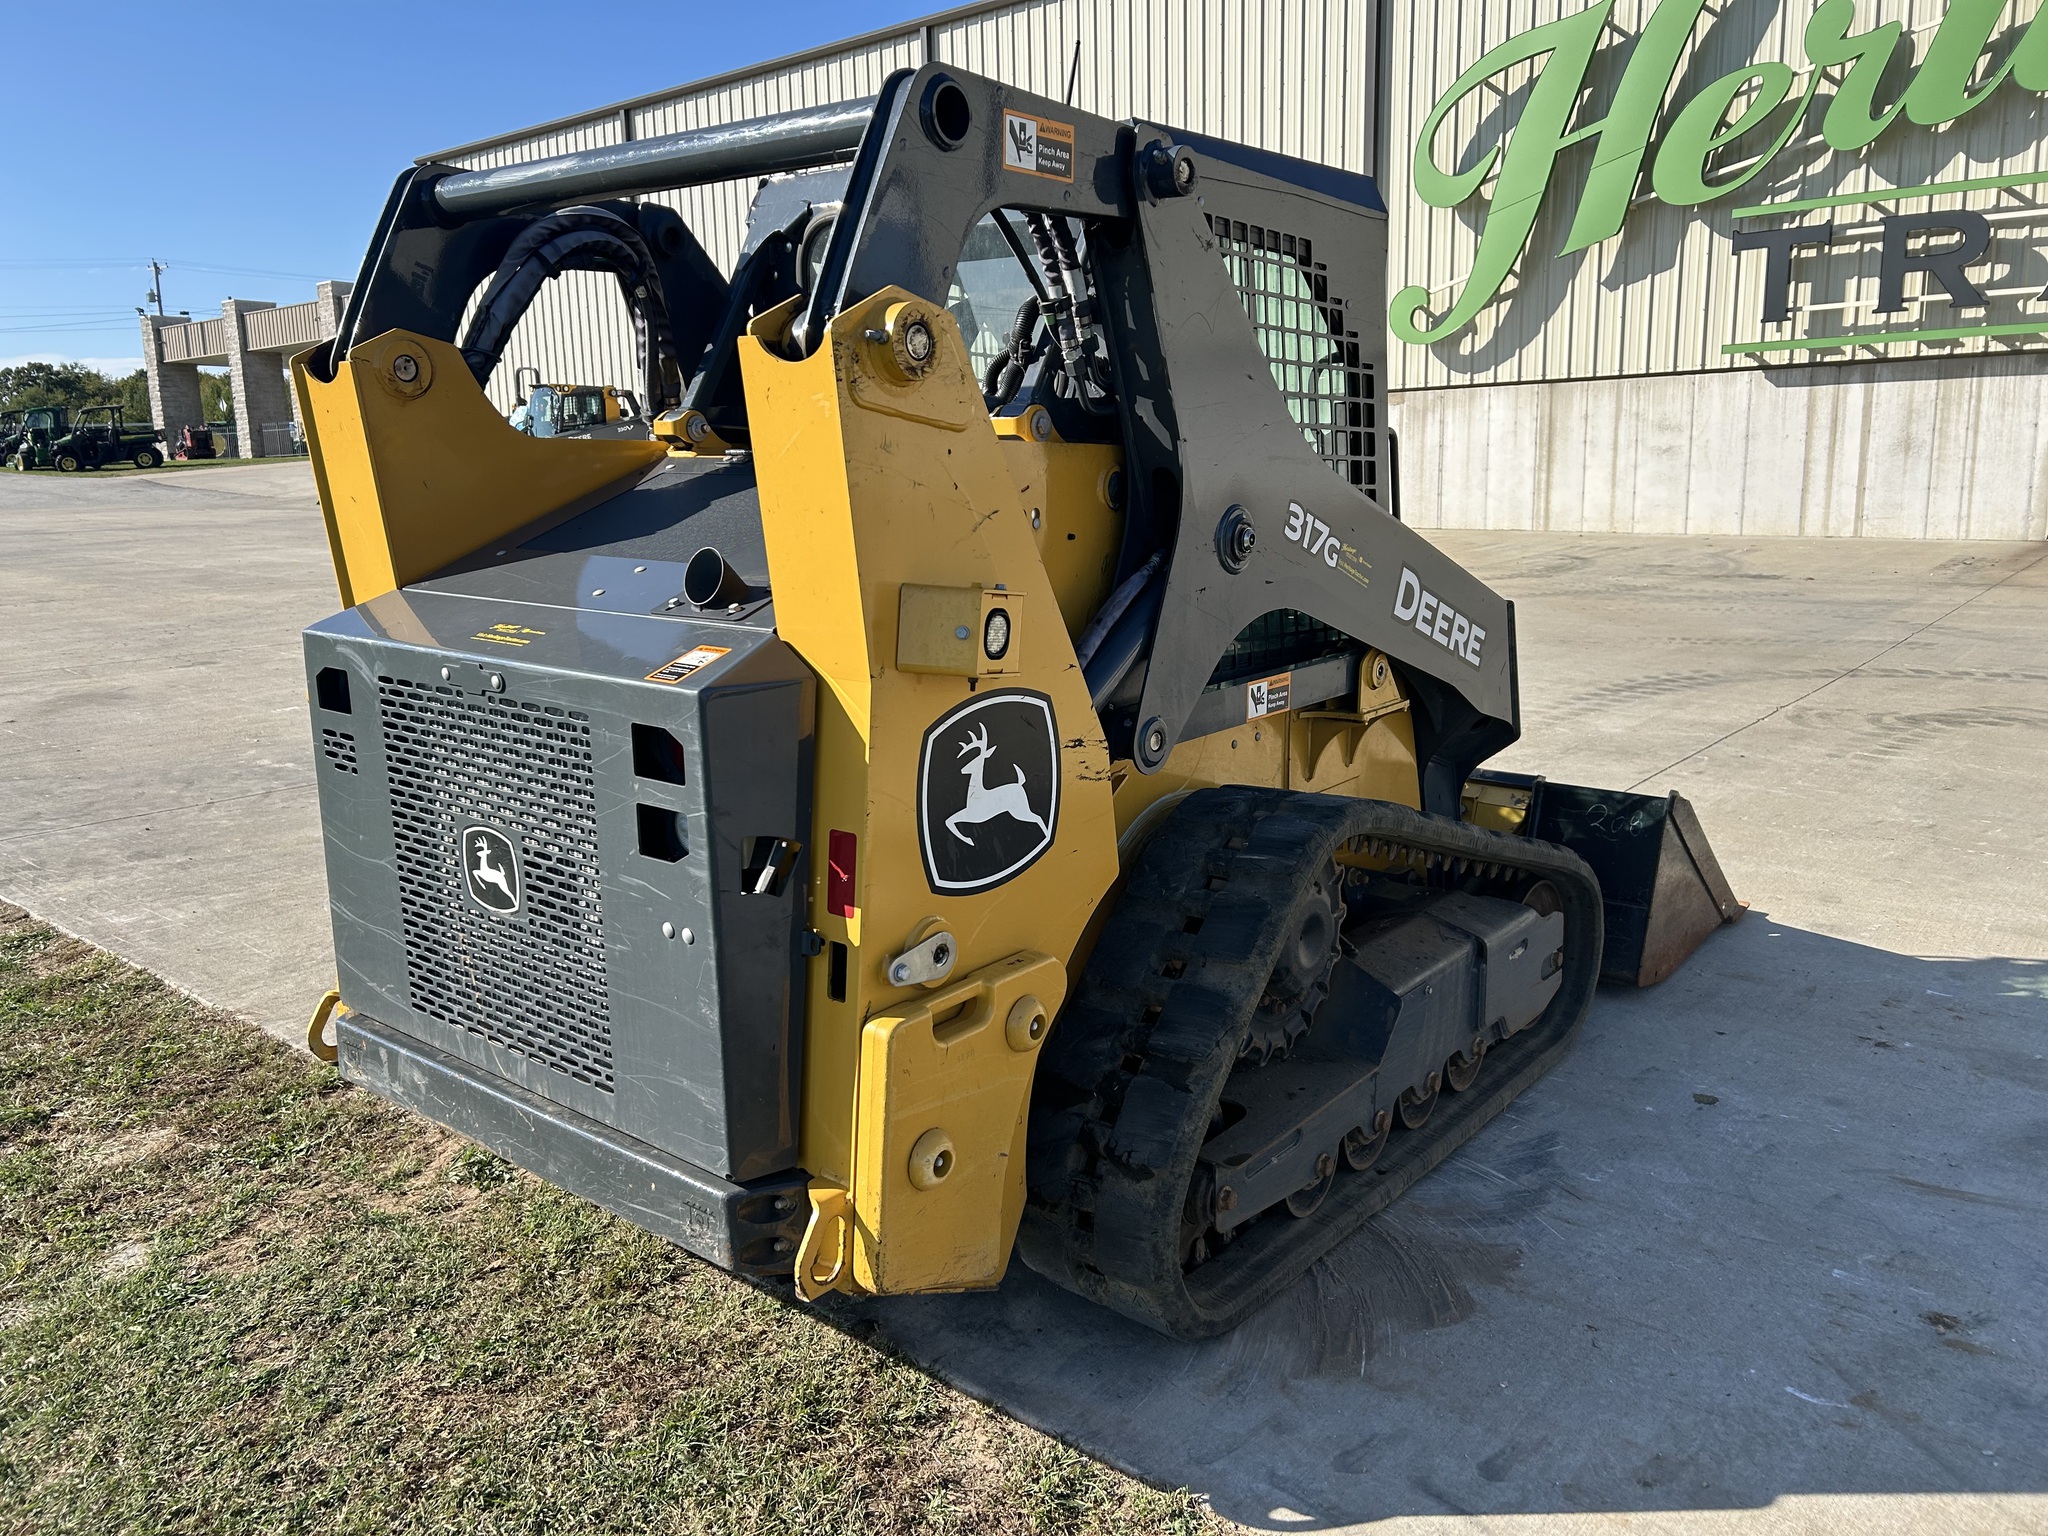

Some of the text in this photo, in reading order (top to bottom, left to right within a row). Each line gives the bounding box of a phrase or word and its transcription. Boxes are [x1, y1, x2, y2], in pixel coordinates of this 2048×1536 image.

[1038, 143, 1070, 160] Pinch Area
[1044, 124, 1072, 139] WARNING
[1038, 156, 1066, 171] Keep Away
[1731, 209, 2048, 324] TR
[1284, 502, 1341, 568] 317G
[1393, 566, 1486, 667] DEERE
